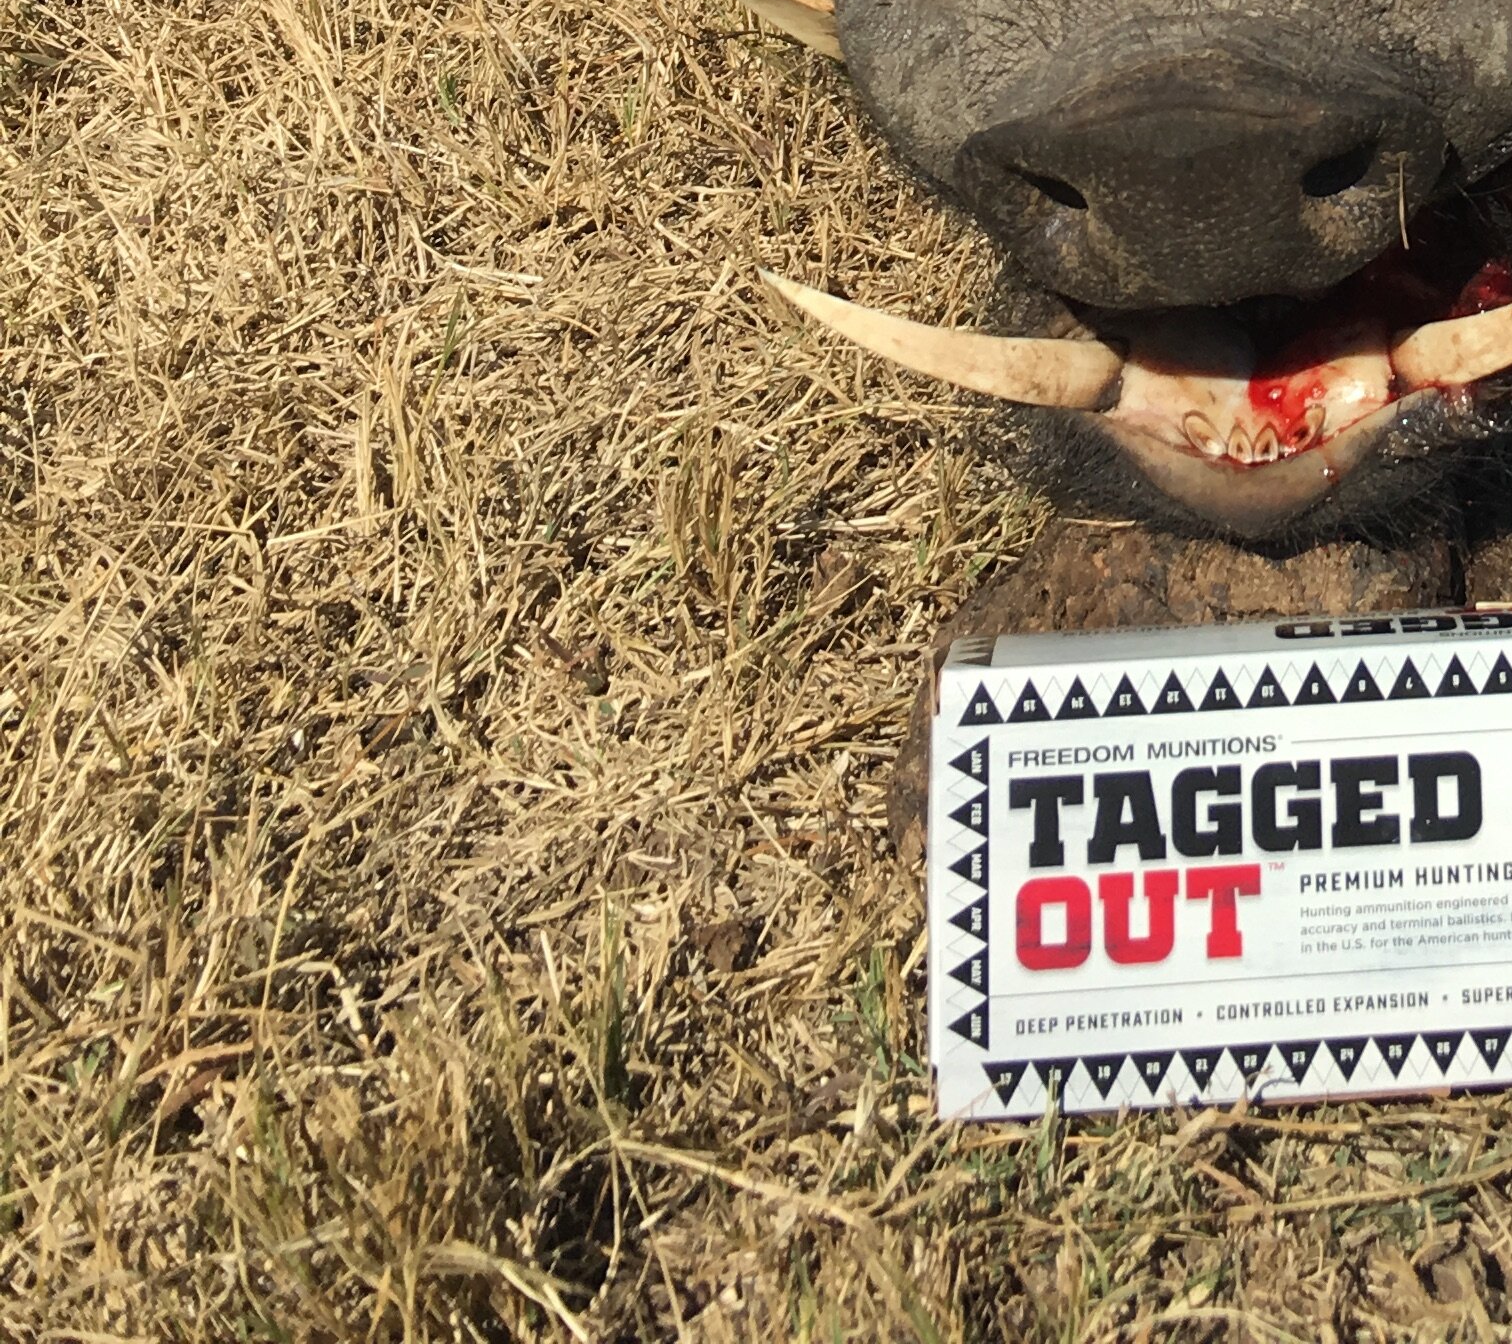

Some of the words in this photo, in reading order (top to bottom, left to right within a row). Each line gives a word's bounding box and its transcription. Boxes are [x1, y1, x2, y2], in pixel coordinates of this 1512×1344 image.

[1405, 676, 1414, 690] 7
[1452, 674, 1460, 687] 6
[1499, 671, 1507, 685] 5
[1214, 687, 1227, 701] 11
[1261, 684, 1275, 698] 10
[1311, 682, 1319, 695] 9
[1071, 696, 1085, 709] 14
[1119, 693, 1132, 707] 13
[1166, 690, 1180, 704] 12
[974, 702, 988, 716] 16
[1023, 699, 1036, 713] 15
[970, 749, 983, 774] JAN
[1008, 744, 1135, 768] FREEDOM
[970, 802, 982, 826] FEB
[1008, 749, 1483, 868] TAGGED
[970, 853, 982, 880] MAR
[1299, 868, 1404, 894] PREMIUM
[1300, 904, 1351, 918] Hunting
[1355, 898, 1433, 915] ammunition
[1436, 893, 1508, 910] engineered
[970, 906, 982, 932] APR
[1015, 862, 1262, 971] OUT
[1300, 922, 1357, 936] accuracy
[1362, 919, 1386, 932] and
[1390, 915, 1443, 930] terminal
[1447, 912, 1507, 927] ballistics.
[1300, 941, 1312, 954] in
[1316, 939, 1338, 953] the
[1341, 937, 1366, 951] U.S.
[1370, 935, 1389, 949] for
[1392, 933, 1413, 947] the
[1417, 930, 1480, 946] American
[970, 959, 982, 986] MAY
[1015, 1018, 1059, 1036] DEEP
[1065, 1008, 1184, 1032] PENETRATION
[1216, 997, 1326, 1021] CONTROLLED
[1333, 991, 1430, 1014] EXPANSION
[970, 1012, 982, 1039] JUN
[1388, 1044, 1403, 1059] 25
[1436, 1041, 1451, 1056] 26
[1484, 1038, 1498, 1053] 27
[1243, 1054, 1258, 1069] 22
[1292, 1050, 1306, 1065] 23
[1340, 1047, 1355, 1062] 24
[1097, 1065, 1111, 1080] 19
[1146, 1061, 1161, 1076] 20
[1195, 1058, 1209, 1073] 21
